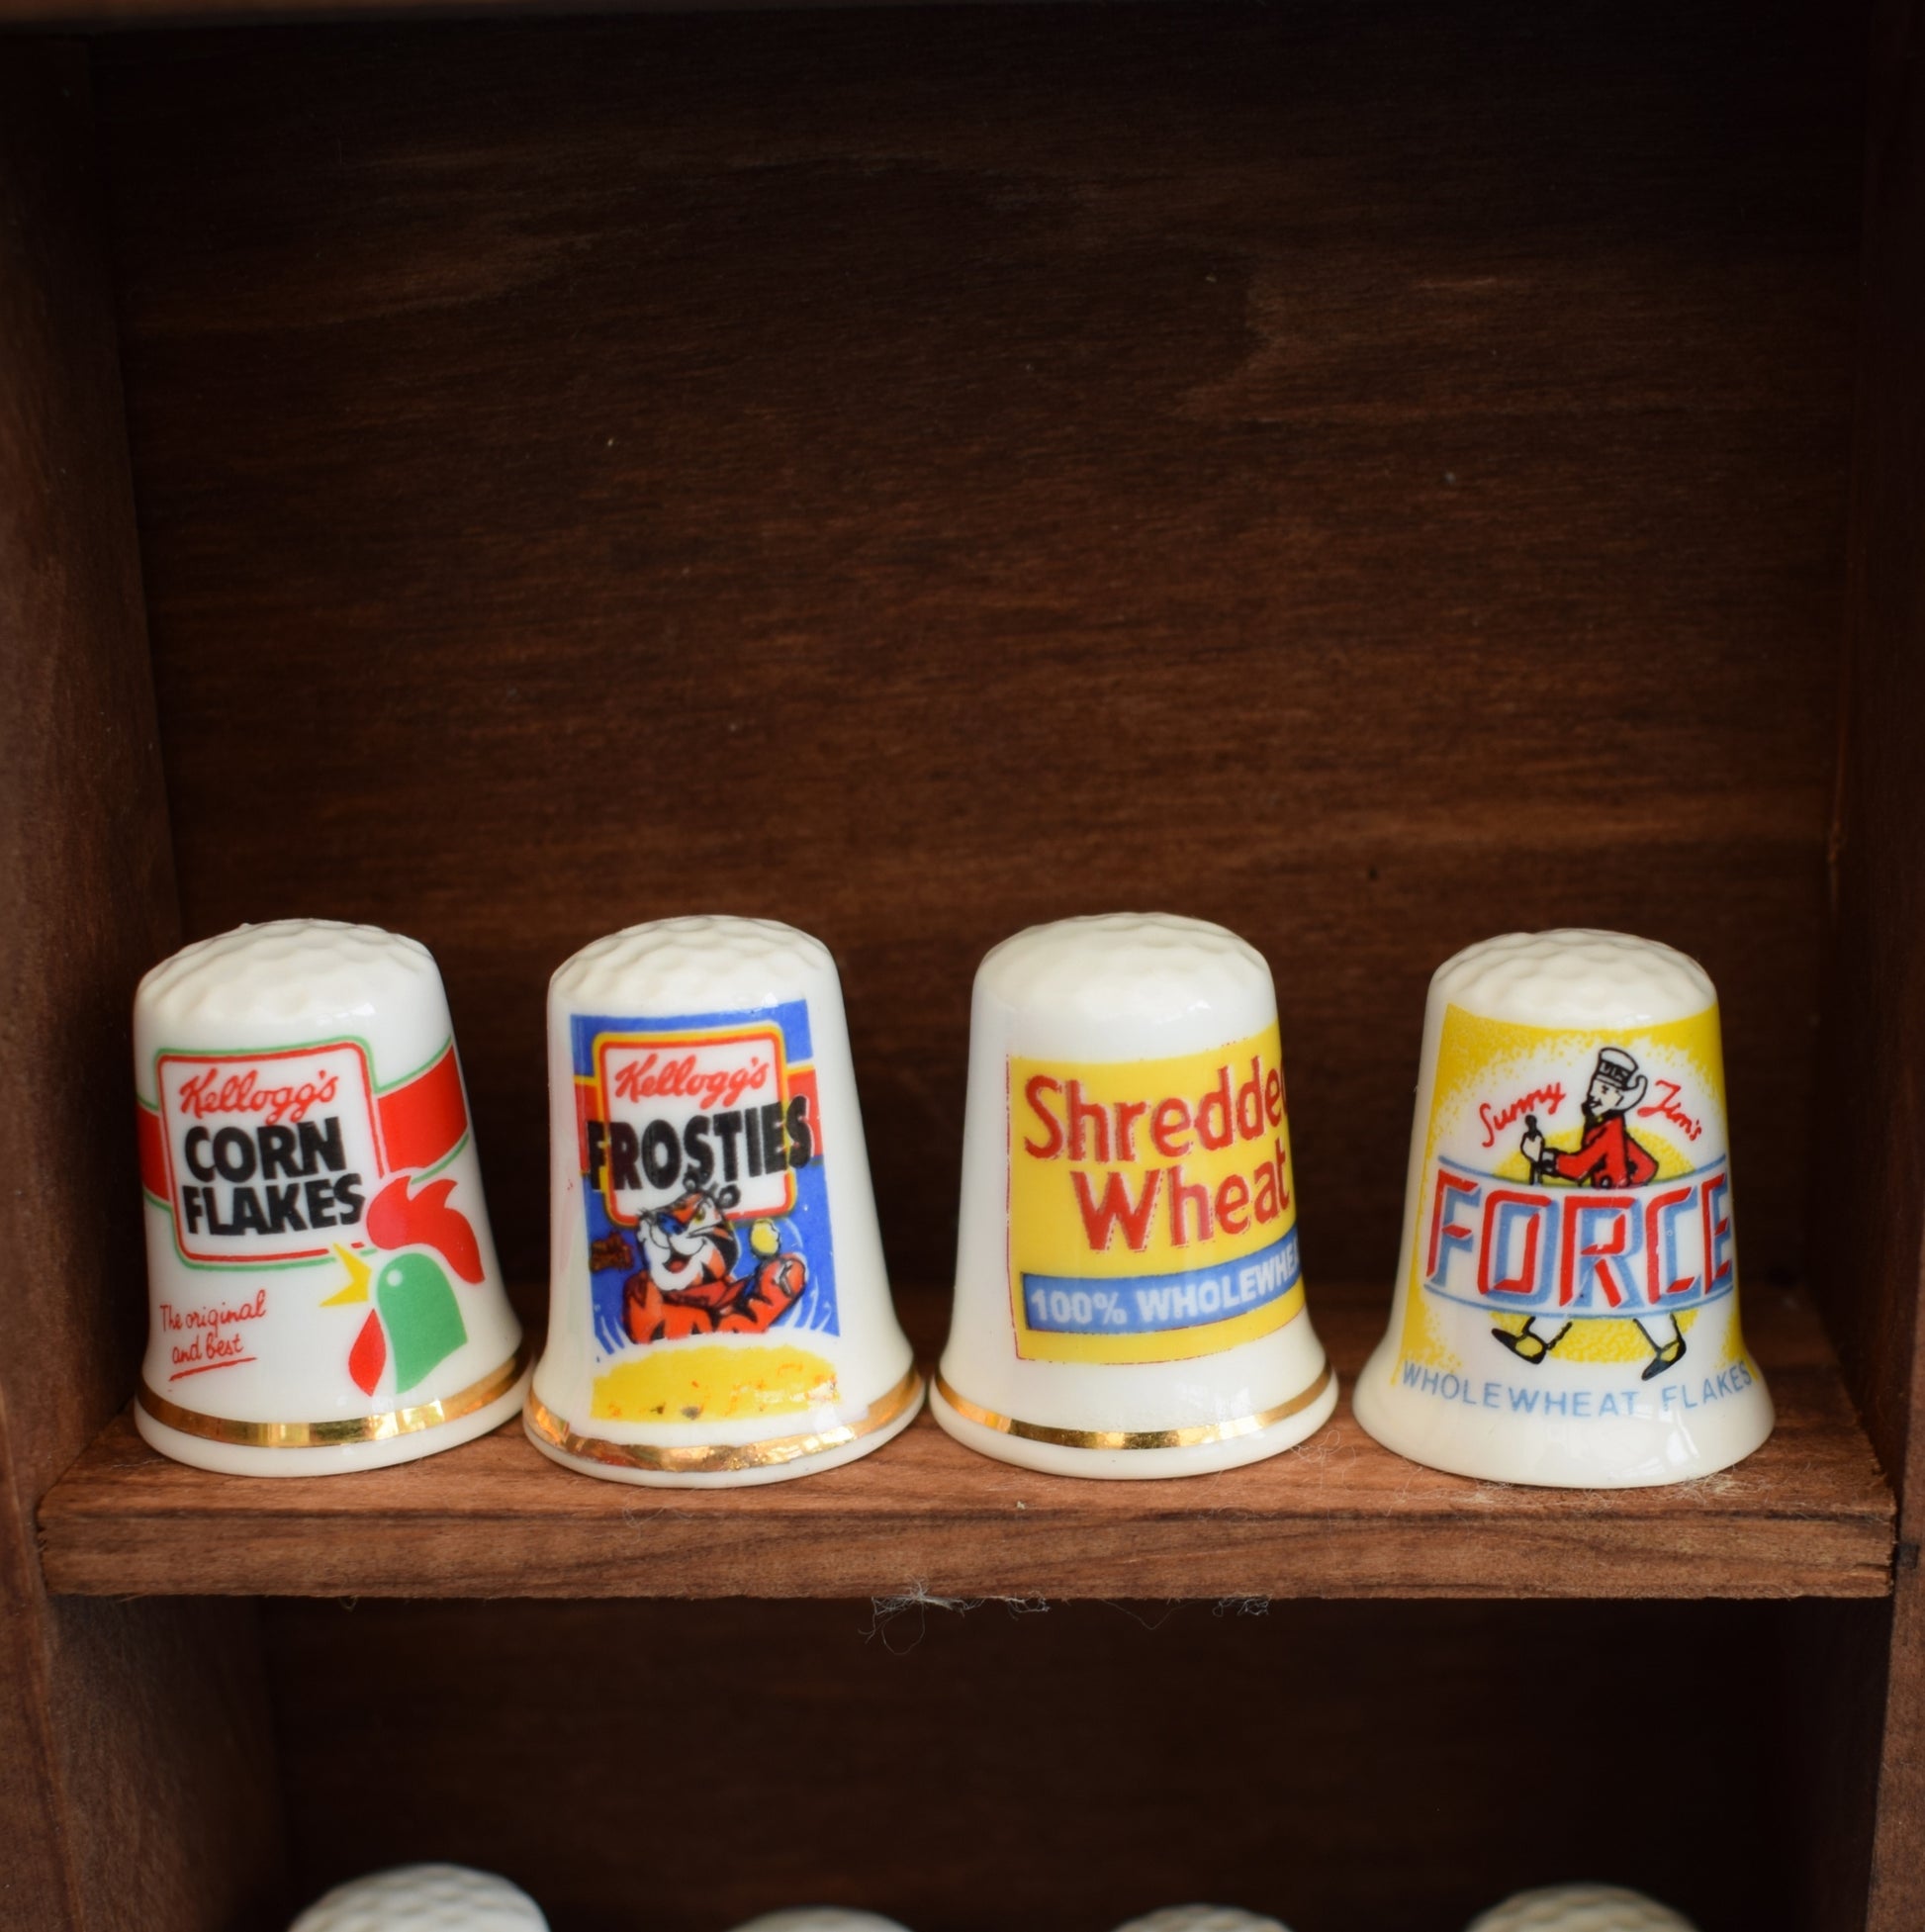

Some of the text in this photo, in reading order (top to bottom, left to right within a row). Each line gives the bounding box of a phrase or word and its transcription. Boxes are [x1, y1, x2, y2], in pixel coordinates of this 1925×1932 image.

[179, 1067, 339, 1125] Kellogg's
[614, 1053, 769, 1110] Kellogg's
[587, 1095, 813, 1191] FROSTIES
[1479, 1081, 1566, 1148] Sunny
[184, 1116, 346, 1183] CORN
[182, 1173, 366, 1237] FLAKES
[1069, 1137, 1290, 1253] Wheat
[1425, 1167, 1733, 1309] FORCE
[159, 1289, 266, 1337] The original
[1031, 1288, 1128, 1326] 100%
[172, 1332, 244, 1364] and best
[1402, 1359, 1753, 1417] WHOLEWHEAT FLAKES
